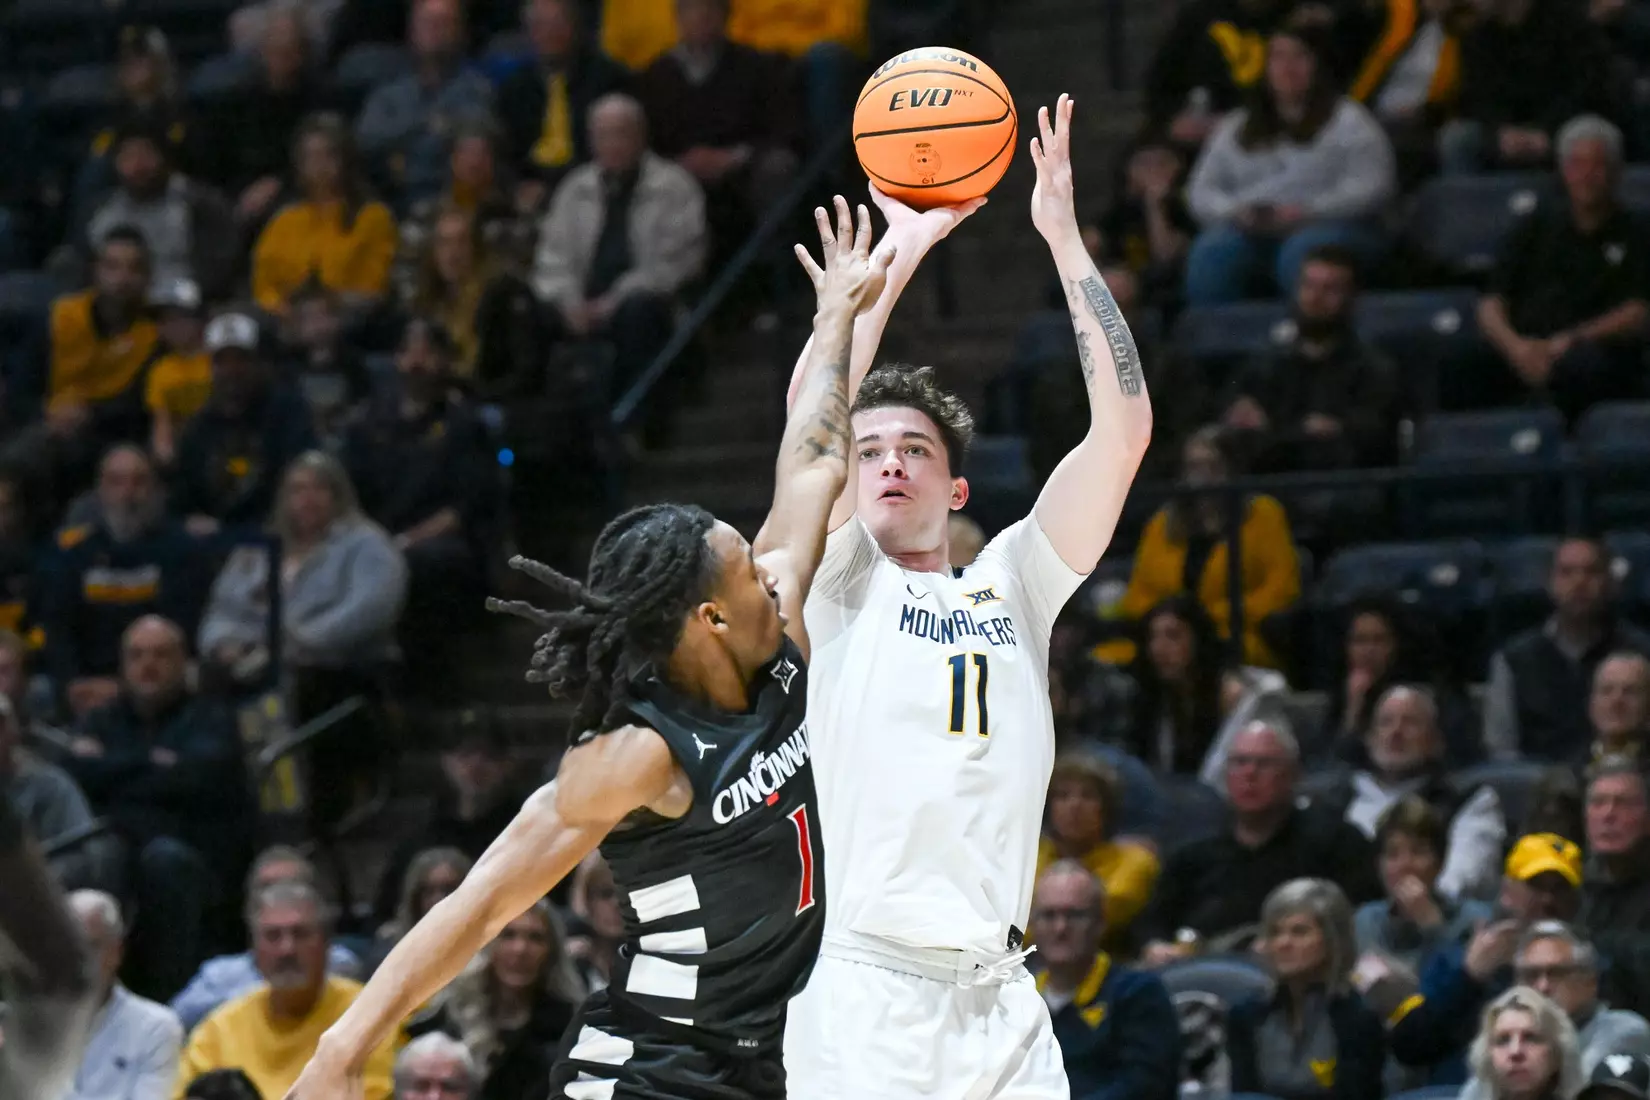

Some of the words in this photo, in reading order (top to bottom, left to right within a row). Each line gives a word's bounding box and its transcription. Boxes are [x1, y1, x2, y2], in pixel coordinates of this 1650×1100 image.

[889, 88, 953, 112] EVO
[953, 89, 975, 98] NXT
[964, 586, 1004, 607] XII
[947, 651, 991, 738] 11
[712, 721, 810, 824] CINCINNAT
[787, 803, 815, 917] 1
